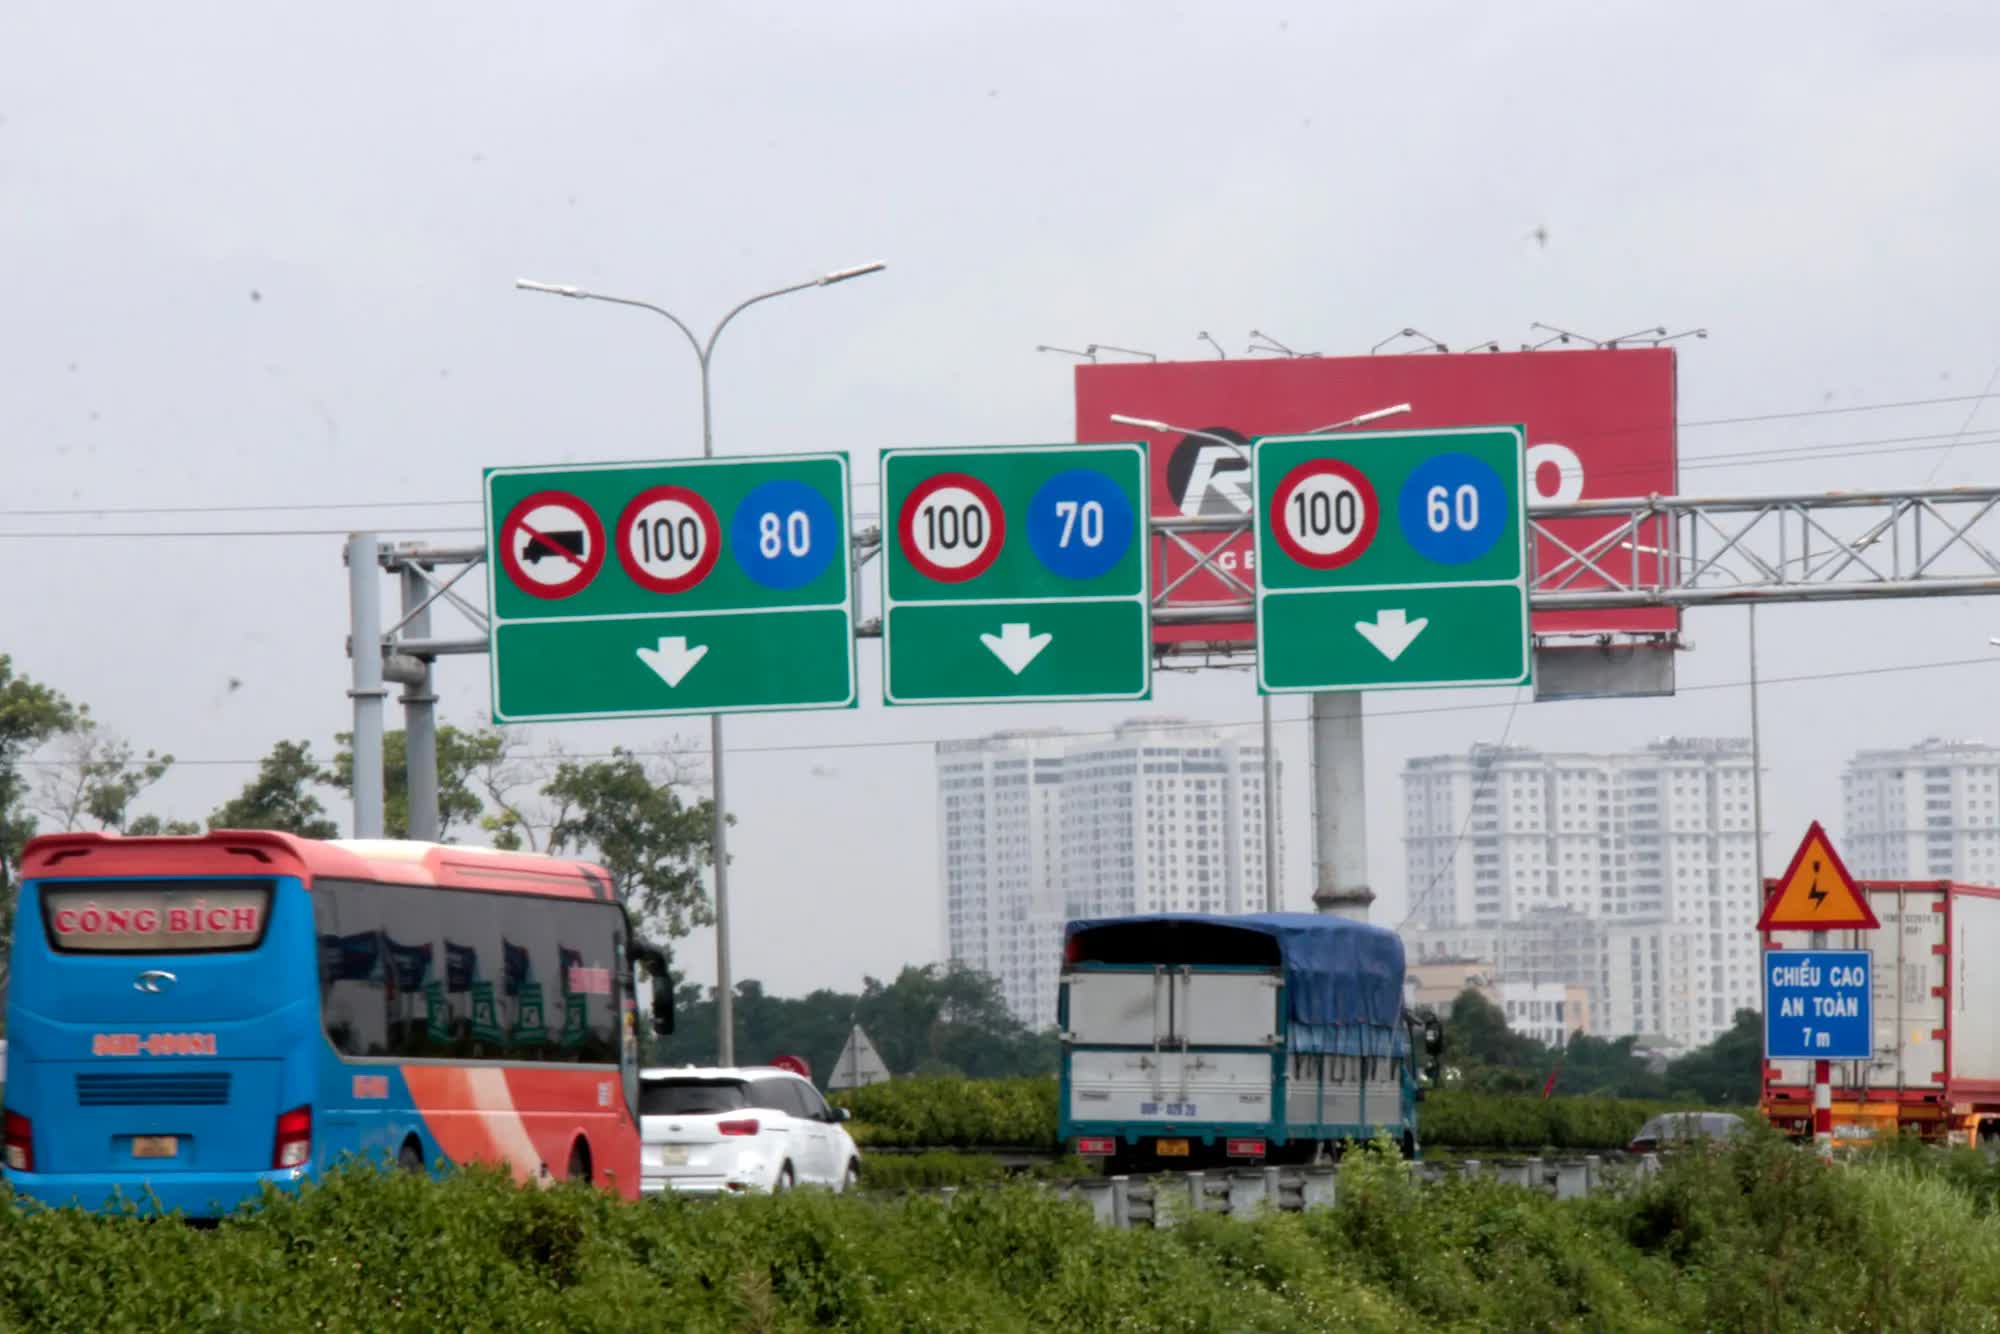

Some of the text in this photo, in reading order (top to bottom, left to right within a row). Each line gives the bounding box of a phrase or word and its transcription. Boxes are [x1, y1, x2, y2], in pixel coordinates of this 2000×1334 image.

[923, 504, 984, 550] 100
[1056, 500, 1104, 548] 70
[1294, 490, 1355, 537] 100
[1427, 484, 1479, 533] 60
[637, 516, 699, 563] 100
[759, 510, 810, 559] 80
[1829, 966, 1865, 987] CAO
[1780, 997, 1804, 1017] AN
[1802, 1027, 1830, 1048] 7 m
